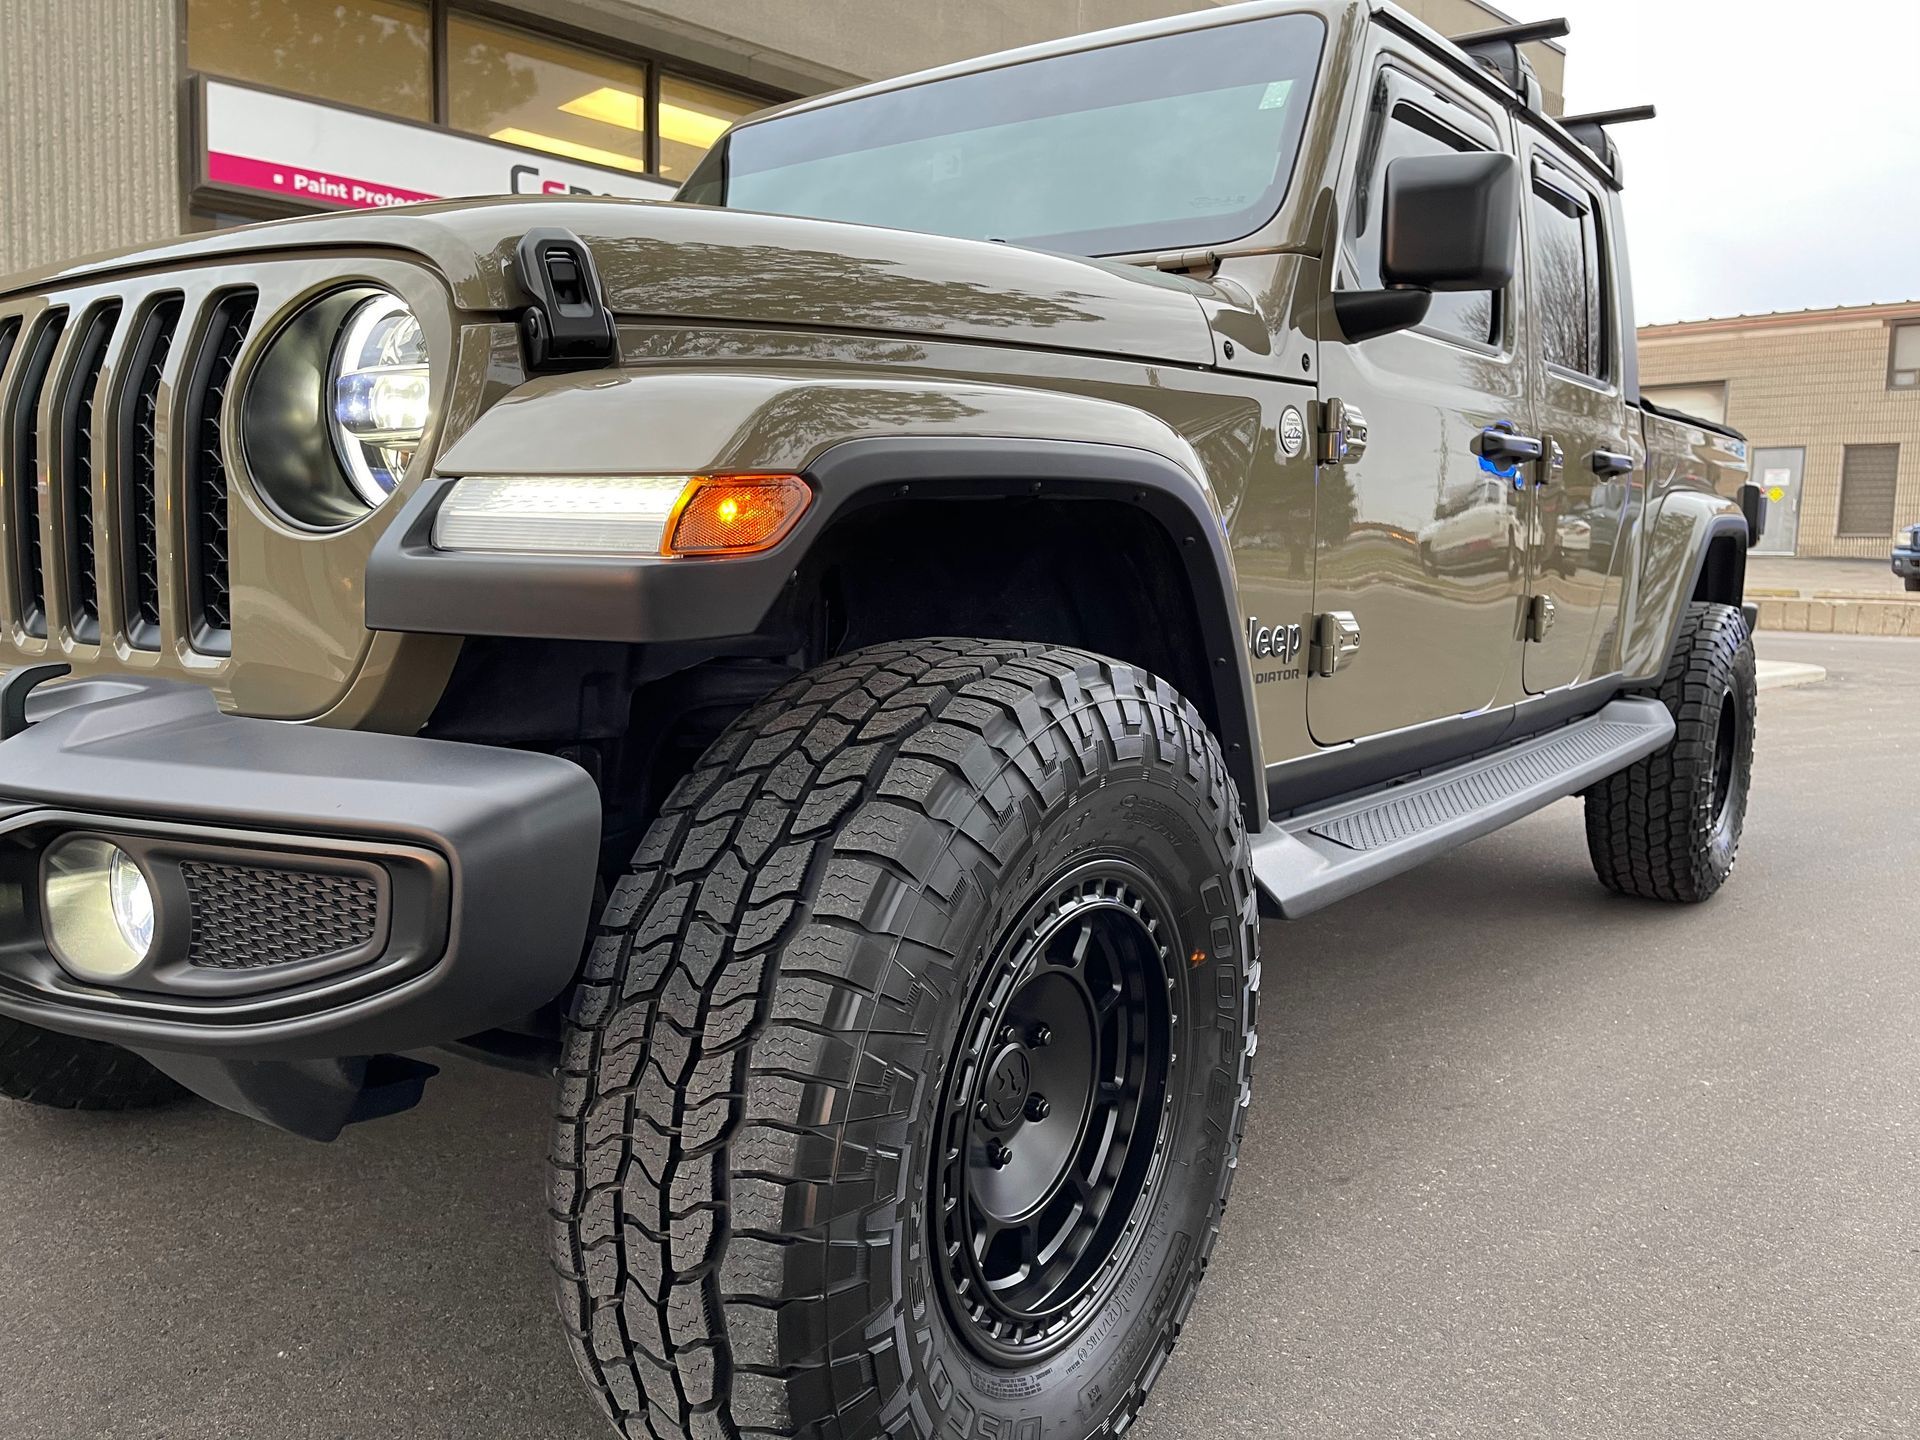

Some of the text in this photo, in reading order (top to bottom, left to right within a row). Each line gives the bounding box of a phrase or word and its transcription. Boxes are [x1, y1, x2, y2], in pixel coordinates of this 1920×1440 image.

[294, 174, 430, 207] Paint Prote
[1248, 616, 1302, 664] Jeep
